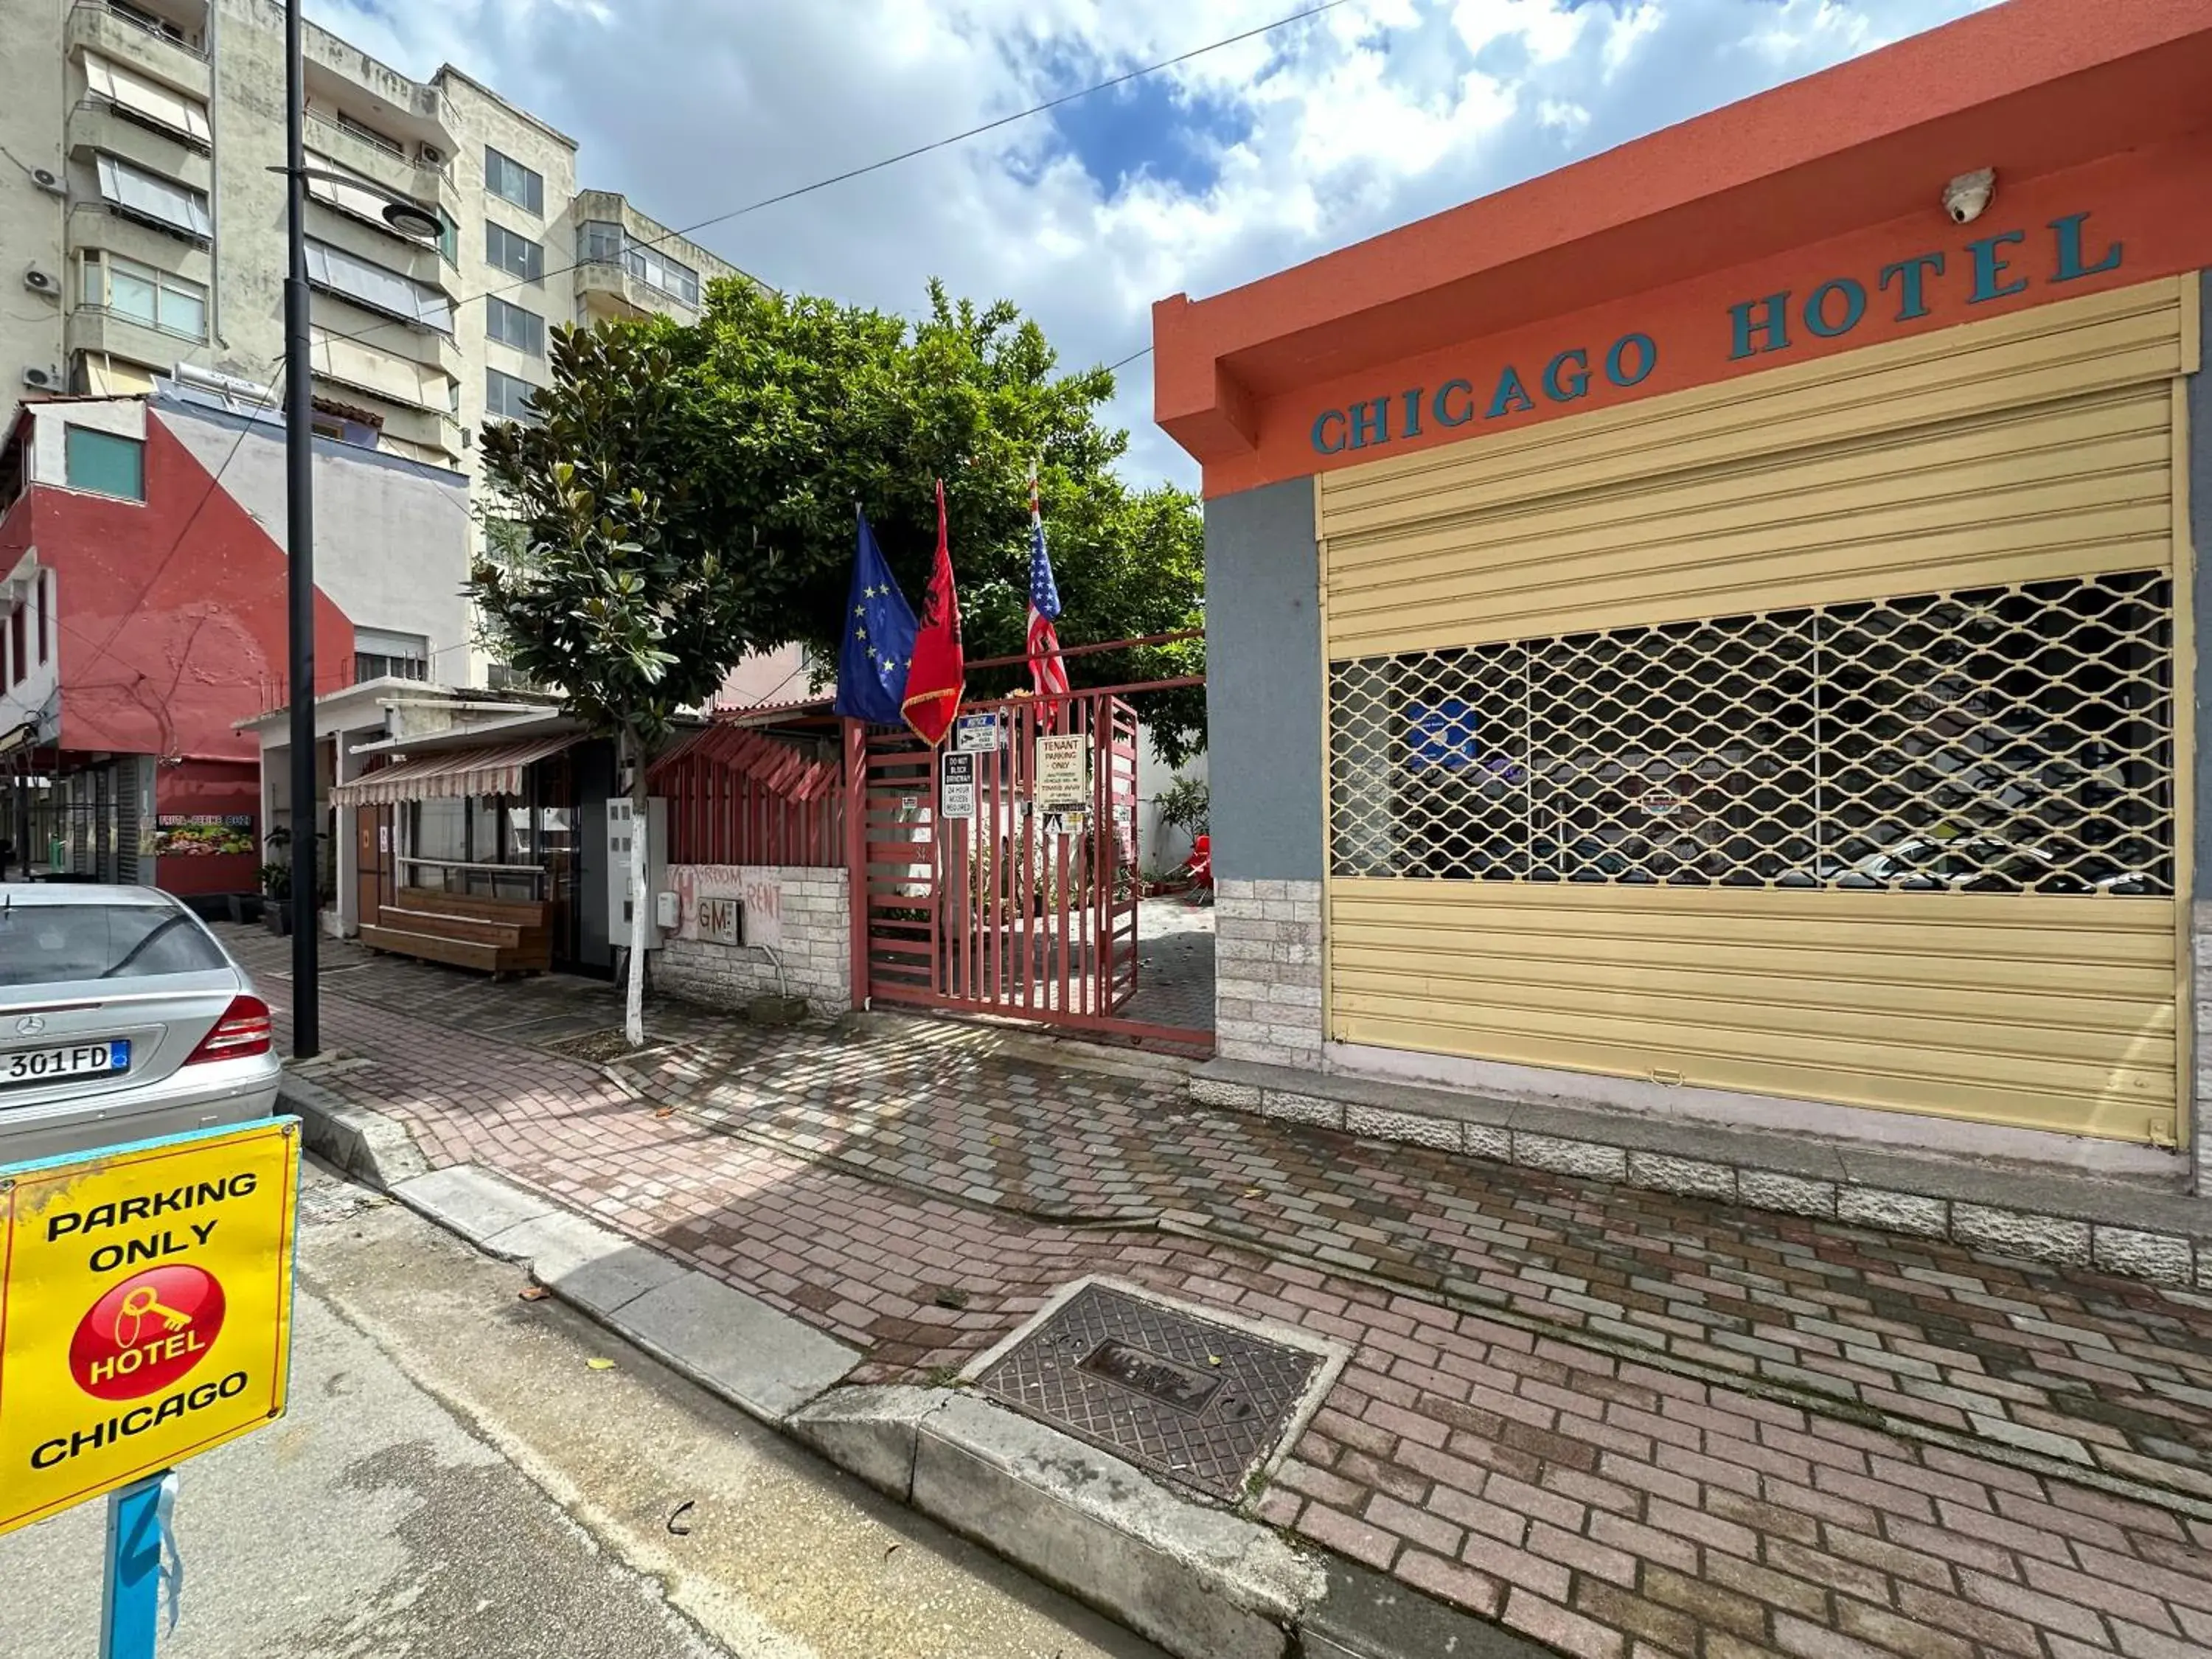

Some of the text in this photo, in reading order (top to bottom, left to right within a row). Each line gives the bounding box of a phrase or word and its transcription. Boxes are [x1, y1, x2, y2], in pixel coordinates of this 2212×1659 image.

[1310, 212, 2123, 455] CHICAGO HOTEL
[1043, 740, 1079, 751] TENANT
[1045, 751, 1077, 760] PARKING
[1051, 761, 1070, 770] ONLY
[746, 883, 782, 920] RENT
[47, 1173, 257, 1242] PARKING
[89, 1220, 218, 1272] ONLY
[90, 1329, 206, 1385] HOTEL
[30, 1371, 248, 1470] CHICAGO
